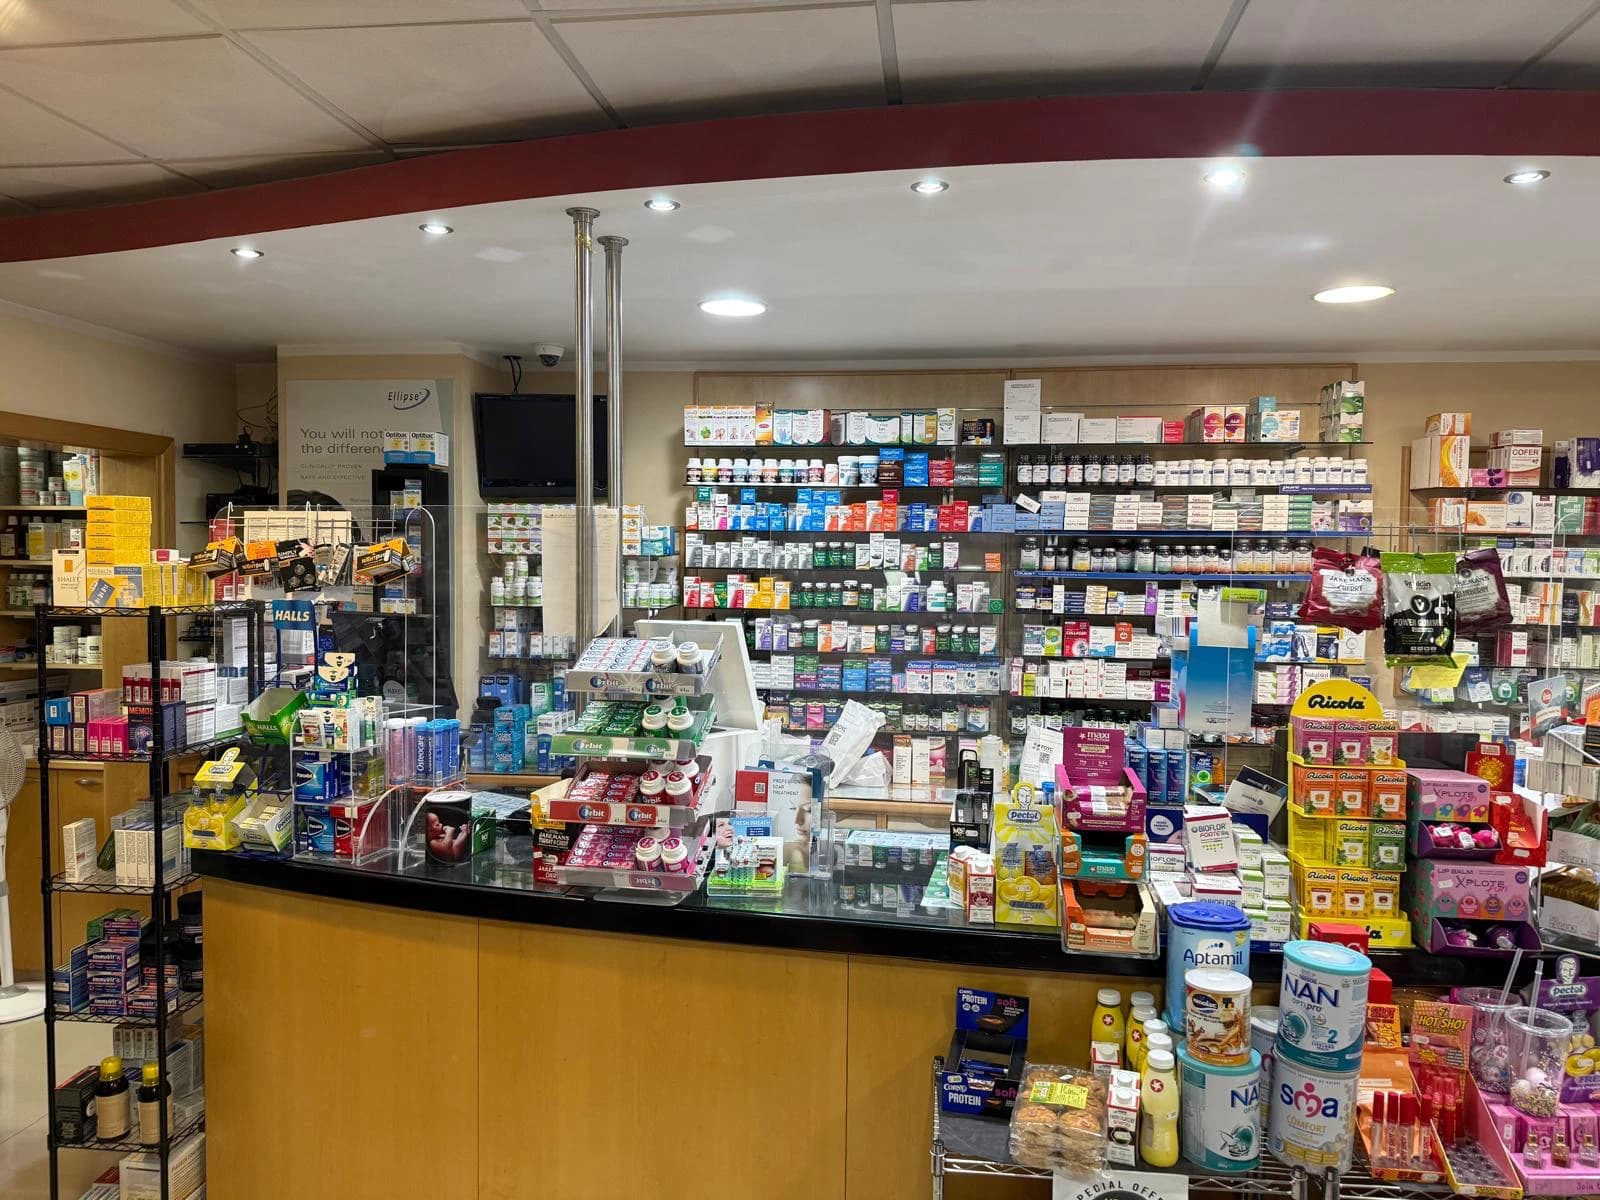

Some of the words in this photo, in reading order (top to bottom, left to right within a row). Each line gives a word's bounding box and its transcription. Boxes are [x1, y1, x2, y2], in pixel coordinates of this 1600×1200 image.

[387, 391, 419, 404] Ellipse
[300, 428, 326, 440] You
[331, 428, 355, 440] will
[360, 428, 386, 440] not
[300, 443, 322, 454] the
[275, 610, 310, 622] HALLS
[1307, 694, 1365, 710] Ricola
[1304, 722, 1332, 731] Ricola
[1337, 723, 1365, 732] Ricola
[1367, 722, 1396, 732] Ricola
[1087, 731, 1110, 740] maxi
[572, 738, 603, 753] Orbit
[1306, 772, 1334, 781] Ricola
[1339, 772, 1367, 781] Ricola
[1375, 775, 1405, 784] Ricola
[578, 804, 605, 821] Orbit
[628, 807, 653, 822] Orbit
[1198, 823, 1227, 832] BIOFLOR
[1339, 823, 1368, 833] Ricola
[1375, 826, 1403, 836] Ricola
[1307, 871, 1336, 881] Ricola
[1341, 873, 1369, 883] Ricola
[1371, 872, 1399, 882] Ricola
[1184, 948, 1243, 967] Aptamil
[1284, 975, 1340, 1008] NAN
[962, 994, 988, 1005] PROTEIN
[997, 998, 1018, 1008] soft
[1371, 1007, 1396, 1019] SHOT
[1419, 1015, 1439, 1027] HOT
[1441, 1018, 1468, 1030] SHOT
[1327, 1029, 1338, 1044] 2
[948, 1092, 982, 1106] PROTEIN
[1231, 1089, 1260, 1108] NA
[1076, 1180, 1124, 1200] PECIAL
